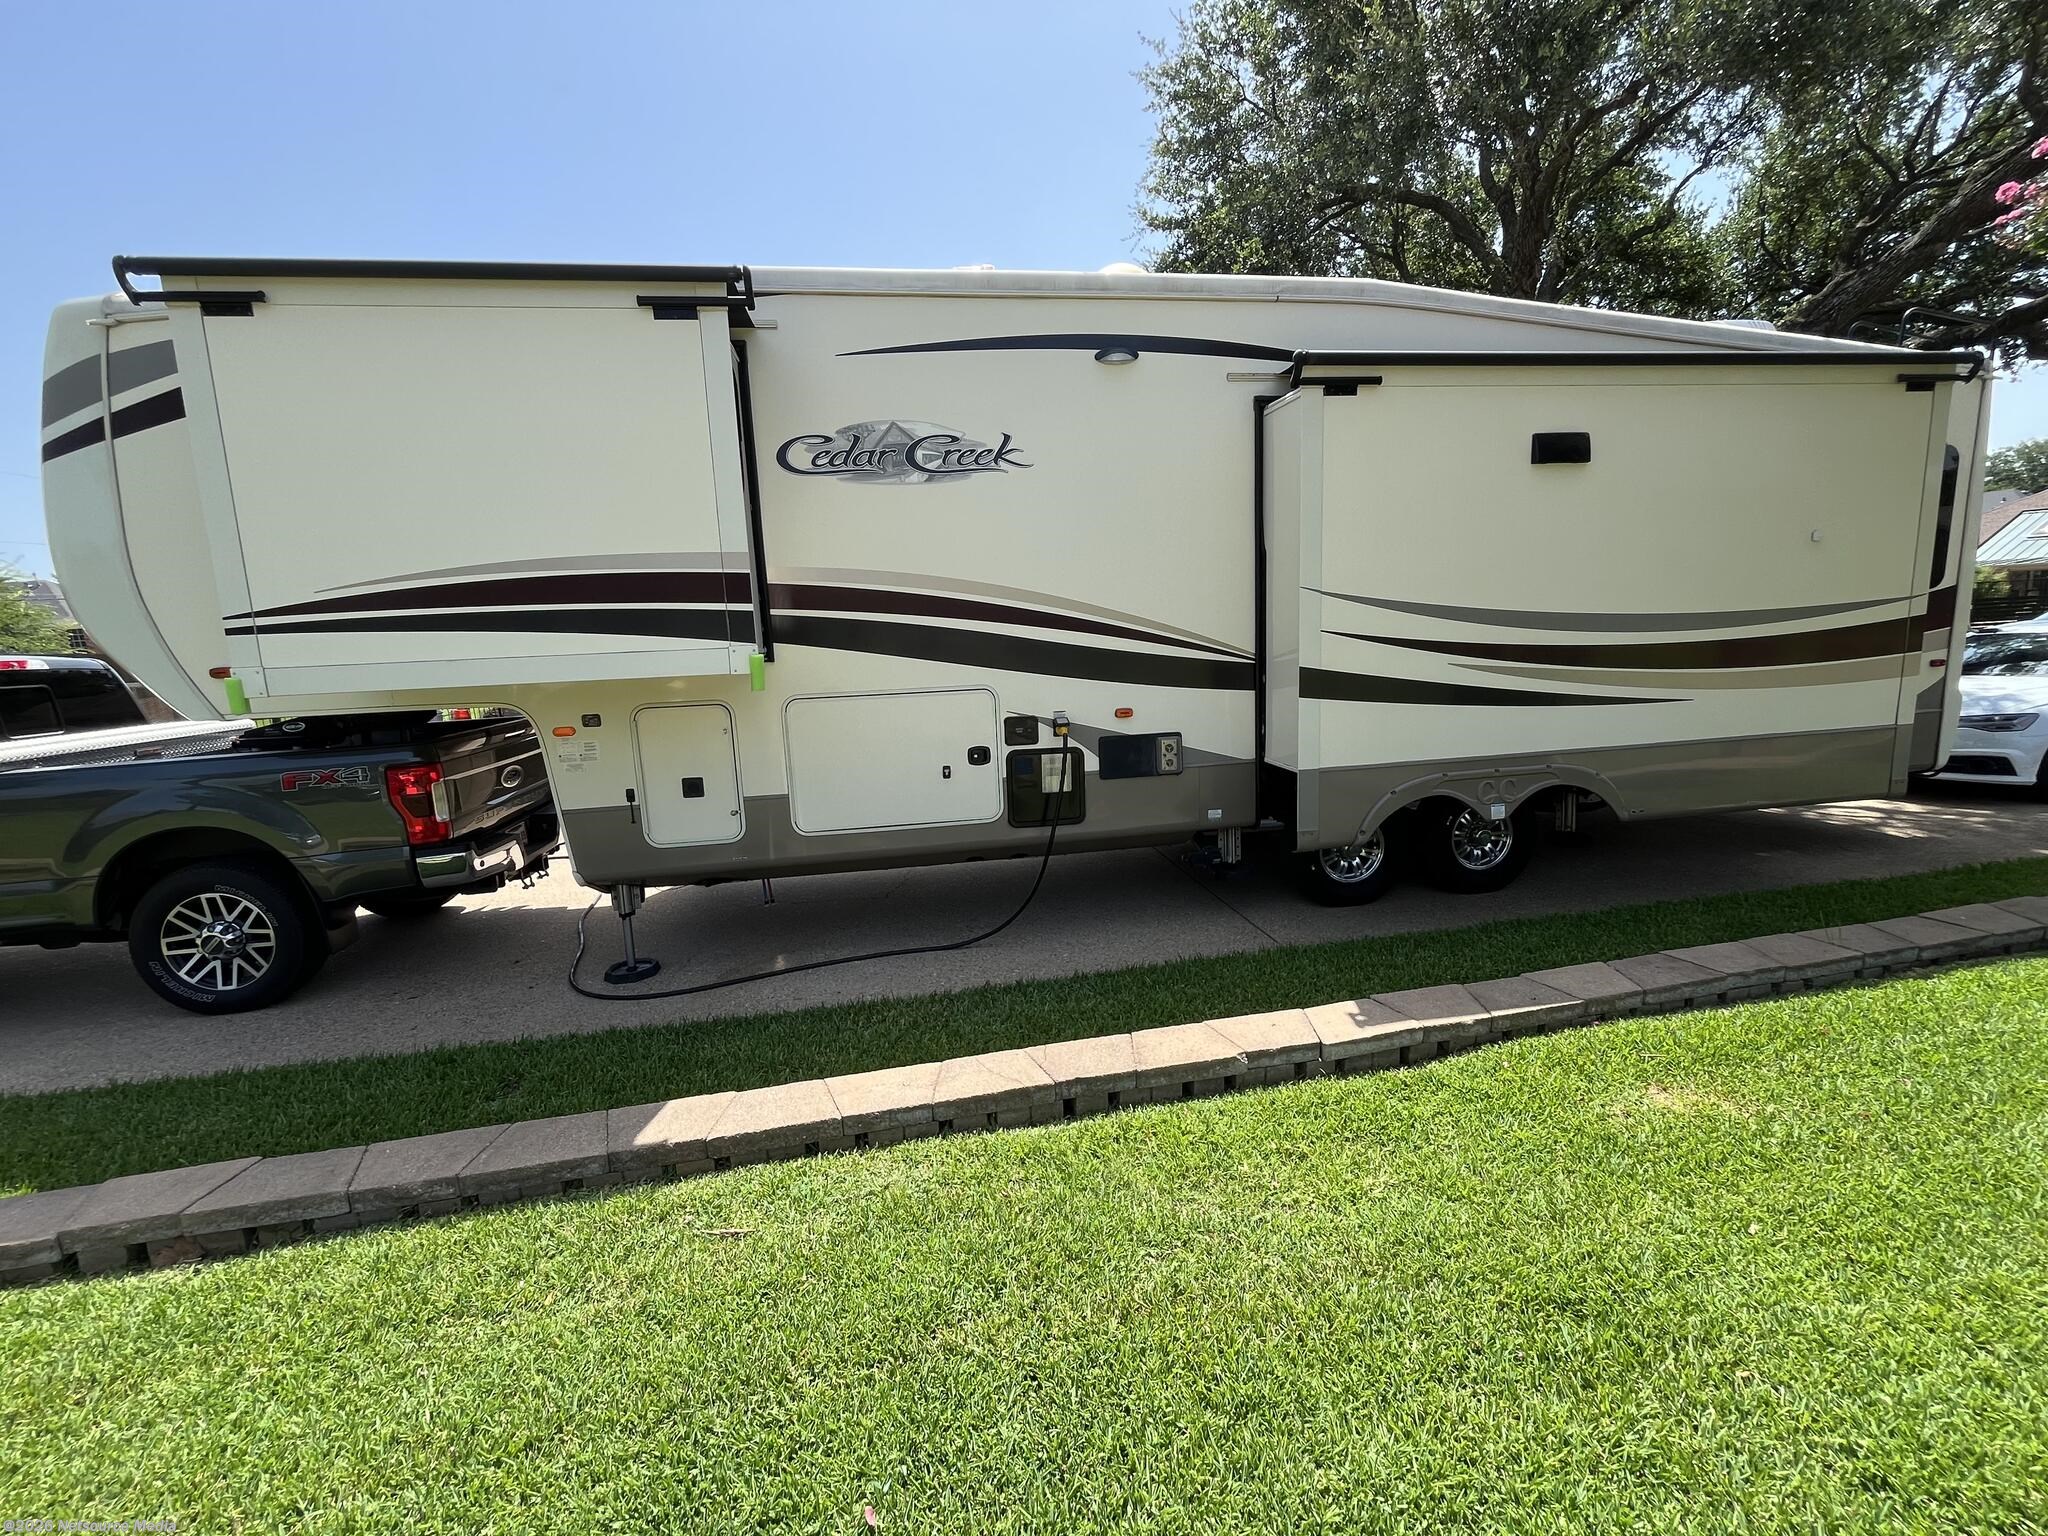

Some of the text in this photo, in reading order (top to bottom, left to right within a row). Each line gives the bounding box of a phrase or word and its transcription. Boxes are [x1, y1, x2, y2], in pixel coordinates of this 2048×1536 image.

[775, 432, 1034, 476] Cedar Creek
[280, 766, 371, 791] FX4
